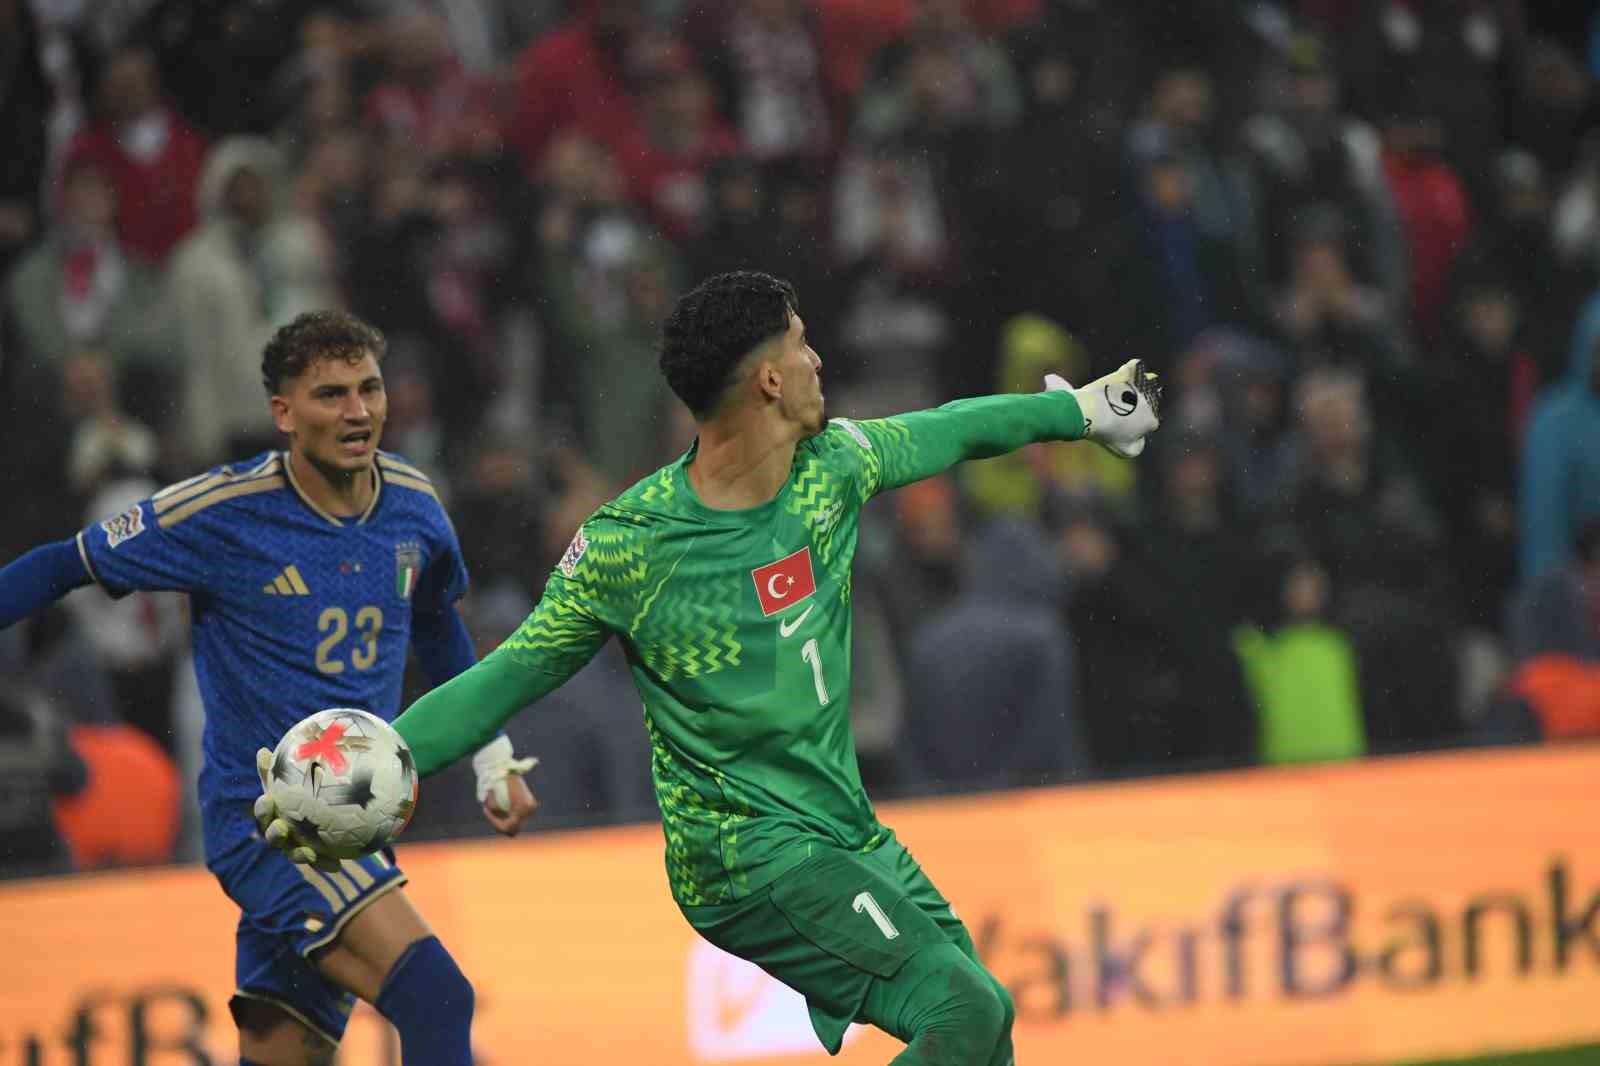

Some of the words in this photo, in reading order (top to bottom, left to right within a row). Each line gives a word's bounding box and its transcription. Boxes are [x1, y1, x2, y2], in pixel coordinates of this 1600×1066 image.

[315, 606, 383, 674] 23
[801, 638, 830, 706] 1
[851, 891, 900, 940] 1
